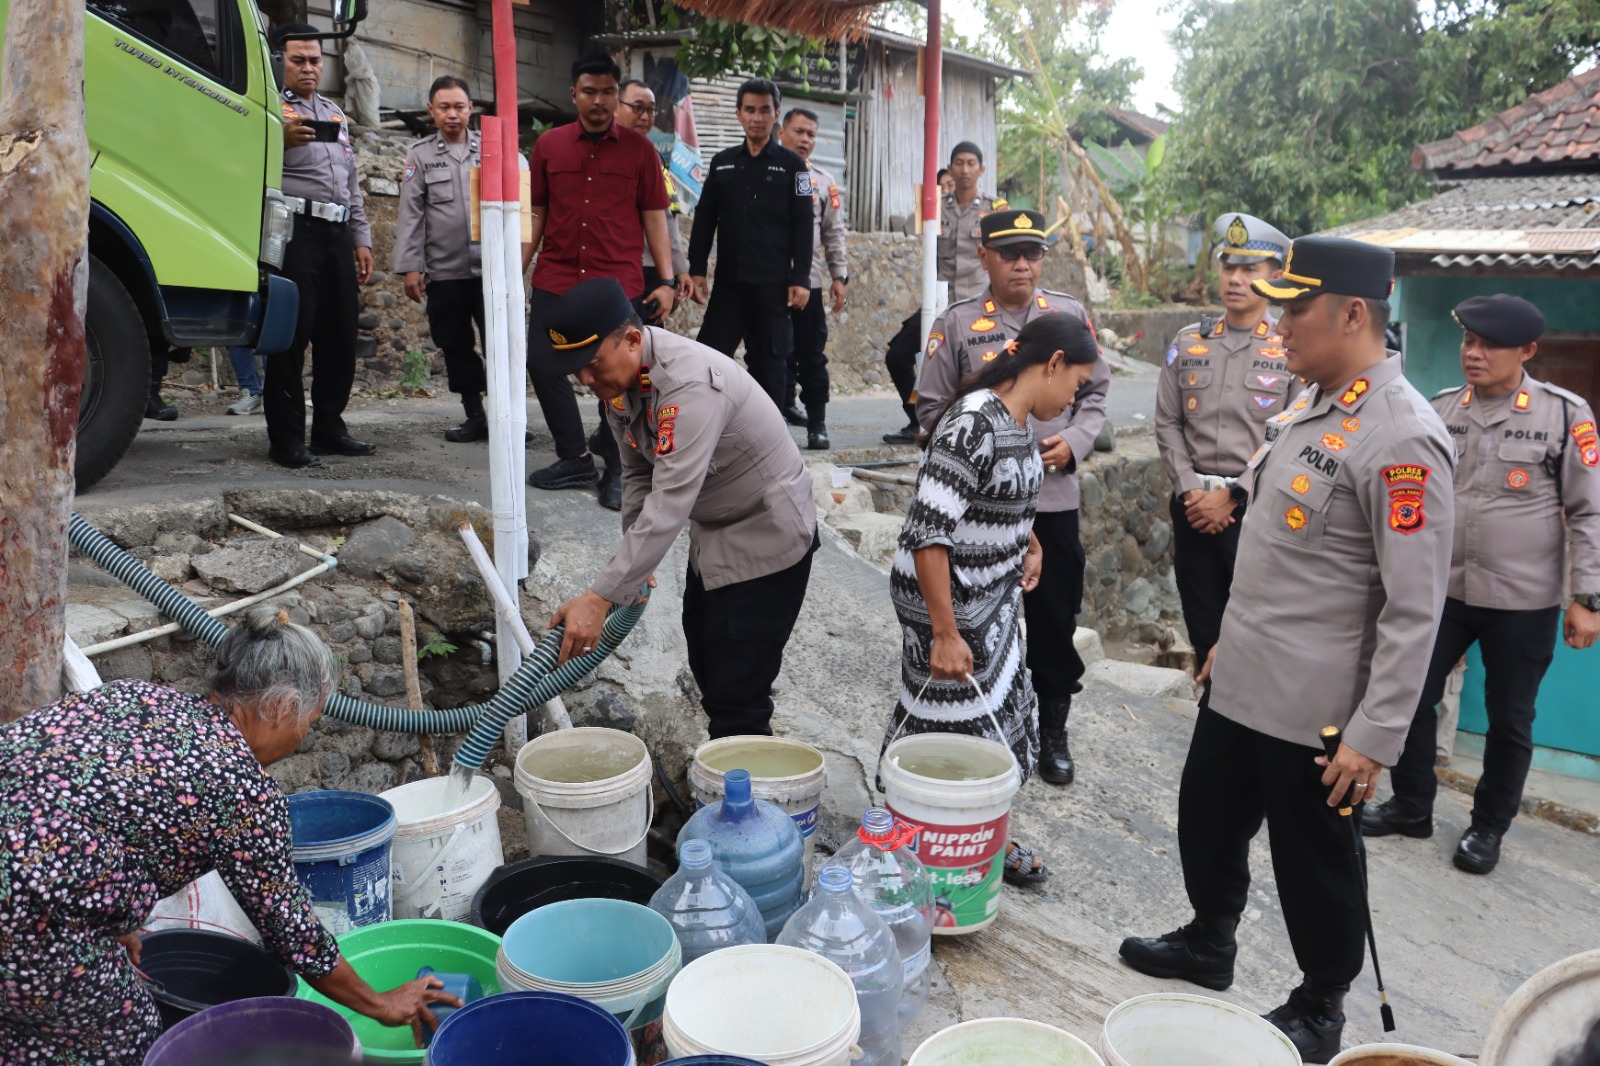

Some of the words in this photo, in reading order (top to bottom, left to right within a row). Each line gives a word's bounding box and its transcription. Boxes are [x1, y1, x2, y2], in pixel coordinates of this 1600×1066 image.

[114, 38, 163, 69] TURBO
[163, 65, 250, 117] INTERCOOLER
[967, 332, 1006, 347] NURJANI
[1252, 360, 1288, 372] POLRI
[1504, 429, 1549, 442] POLRI
[1298, 445, 1339, 478] POLRI
[1389, 466, 1422, 476] POLRES
[1389, 473, 1424, 482] KUNINGAN
[922, 827, 995, 846] NIPPON
[929, 842, 988, 857] PAINT
[930, 871, 983, 886] t-less
